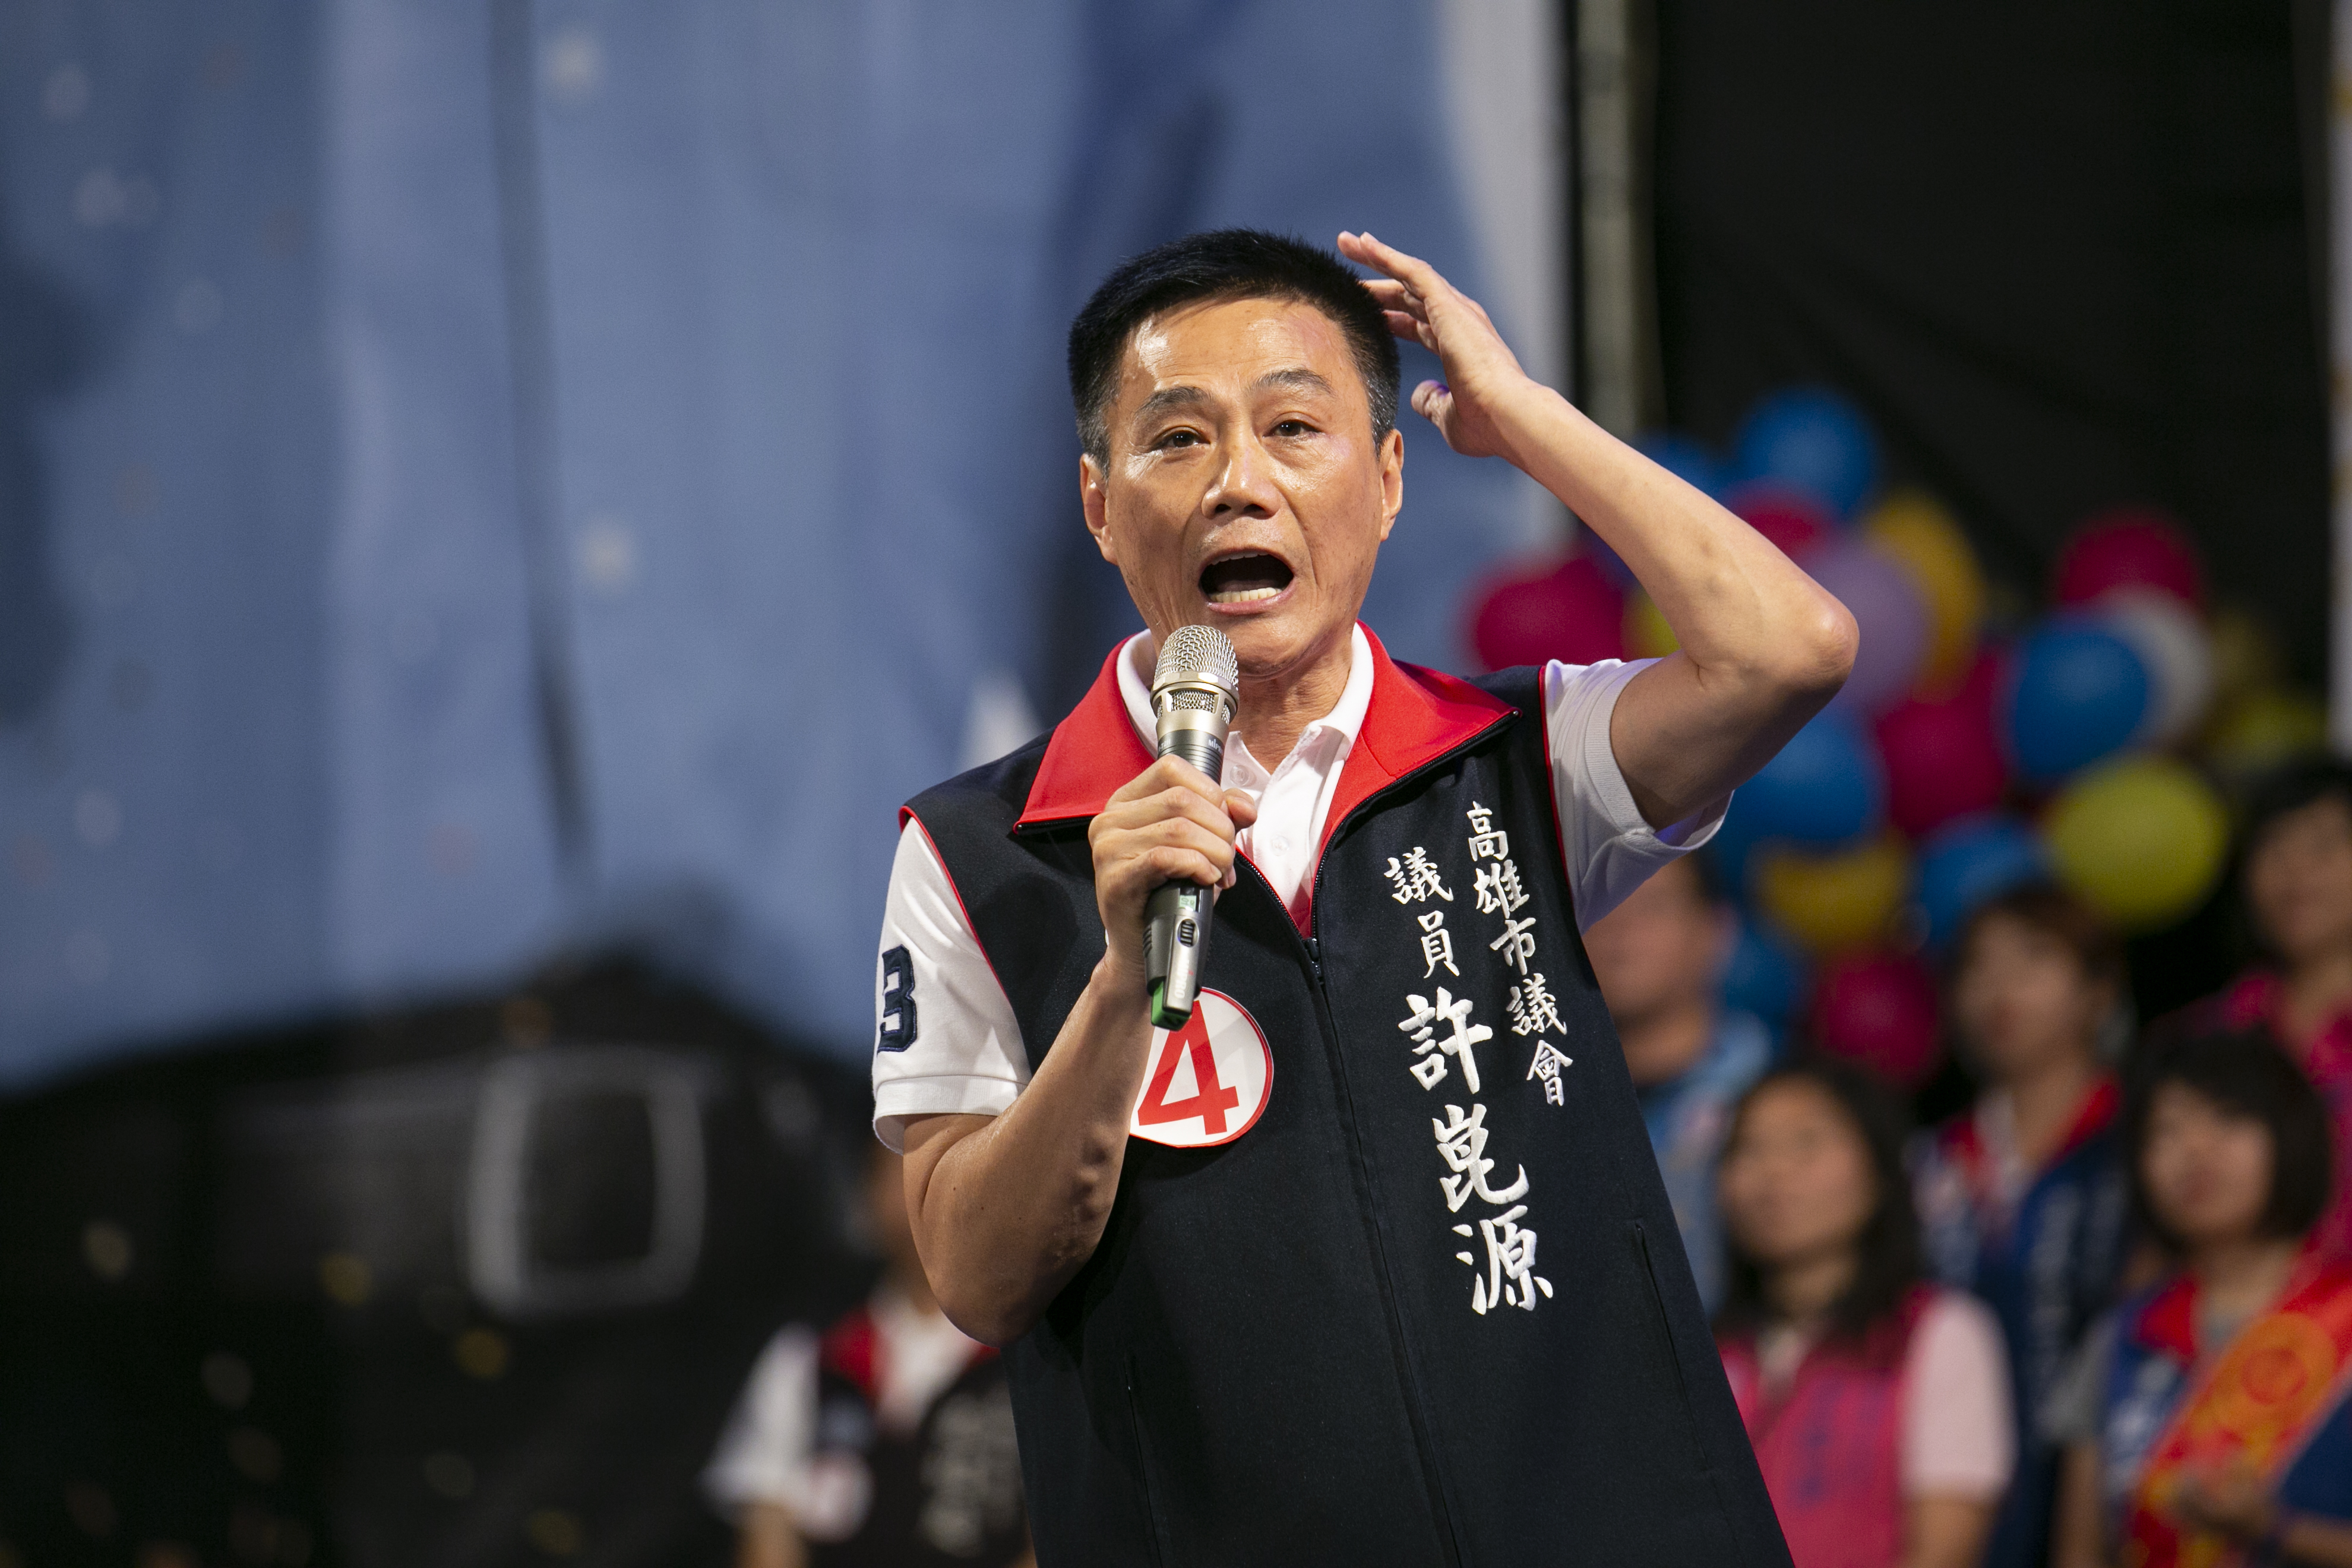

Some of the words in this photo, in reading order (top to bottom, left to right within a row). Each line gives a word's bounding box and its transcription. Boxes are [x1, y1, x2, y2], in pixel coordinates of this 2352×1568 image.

[1383, 846, 1460, 979] 議員
[1466, 801, 1573, 1106] 高雄市議會
[1137, 1000, 1240, 1136] 4
[1398, 986, 1554, 1315] 許崑源
